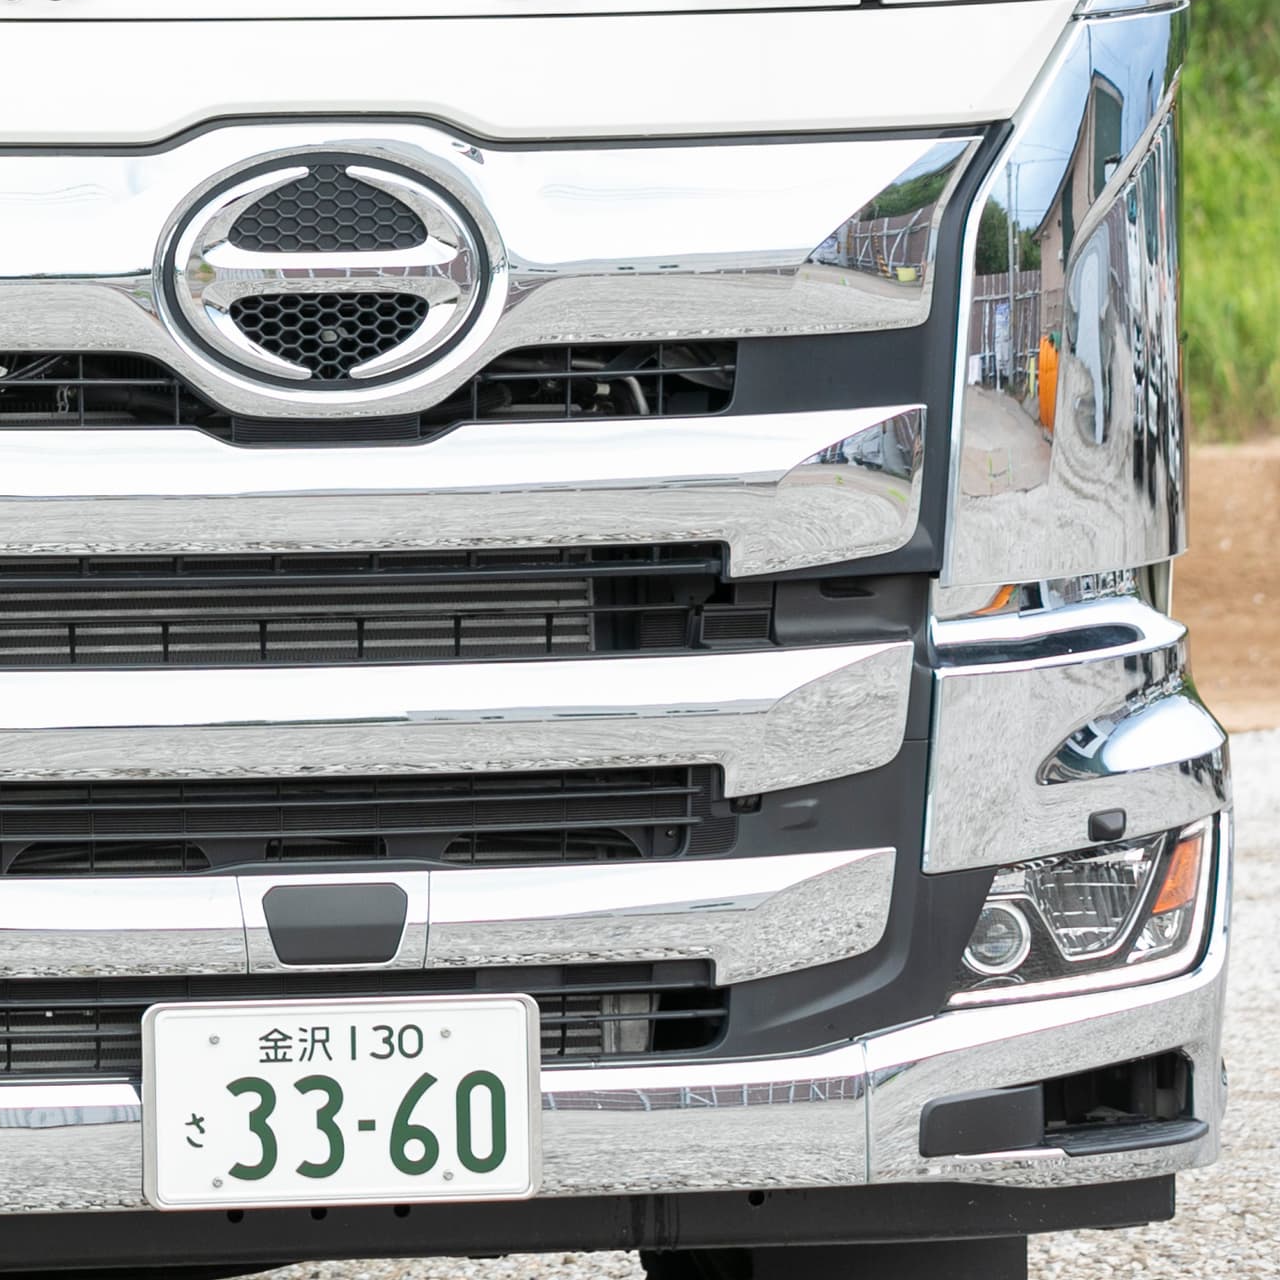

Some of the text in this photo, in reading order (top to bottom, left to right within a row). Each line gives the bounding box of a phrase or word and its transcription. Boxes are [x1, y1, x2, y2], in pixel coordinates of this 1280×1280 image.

[258, 1023, 424, 1063] 金沢 130
[184, 1069, 507, 1181] さ 33-60
